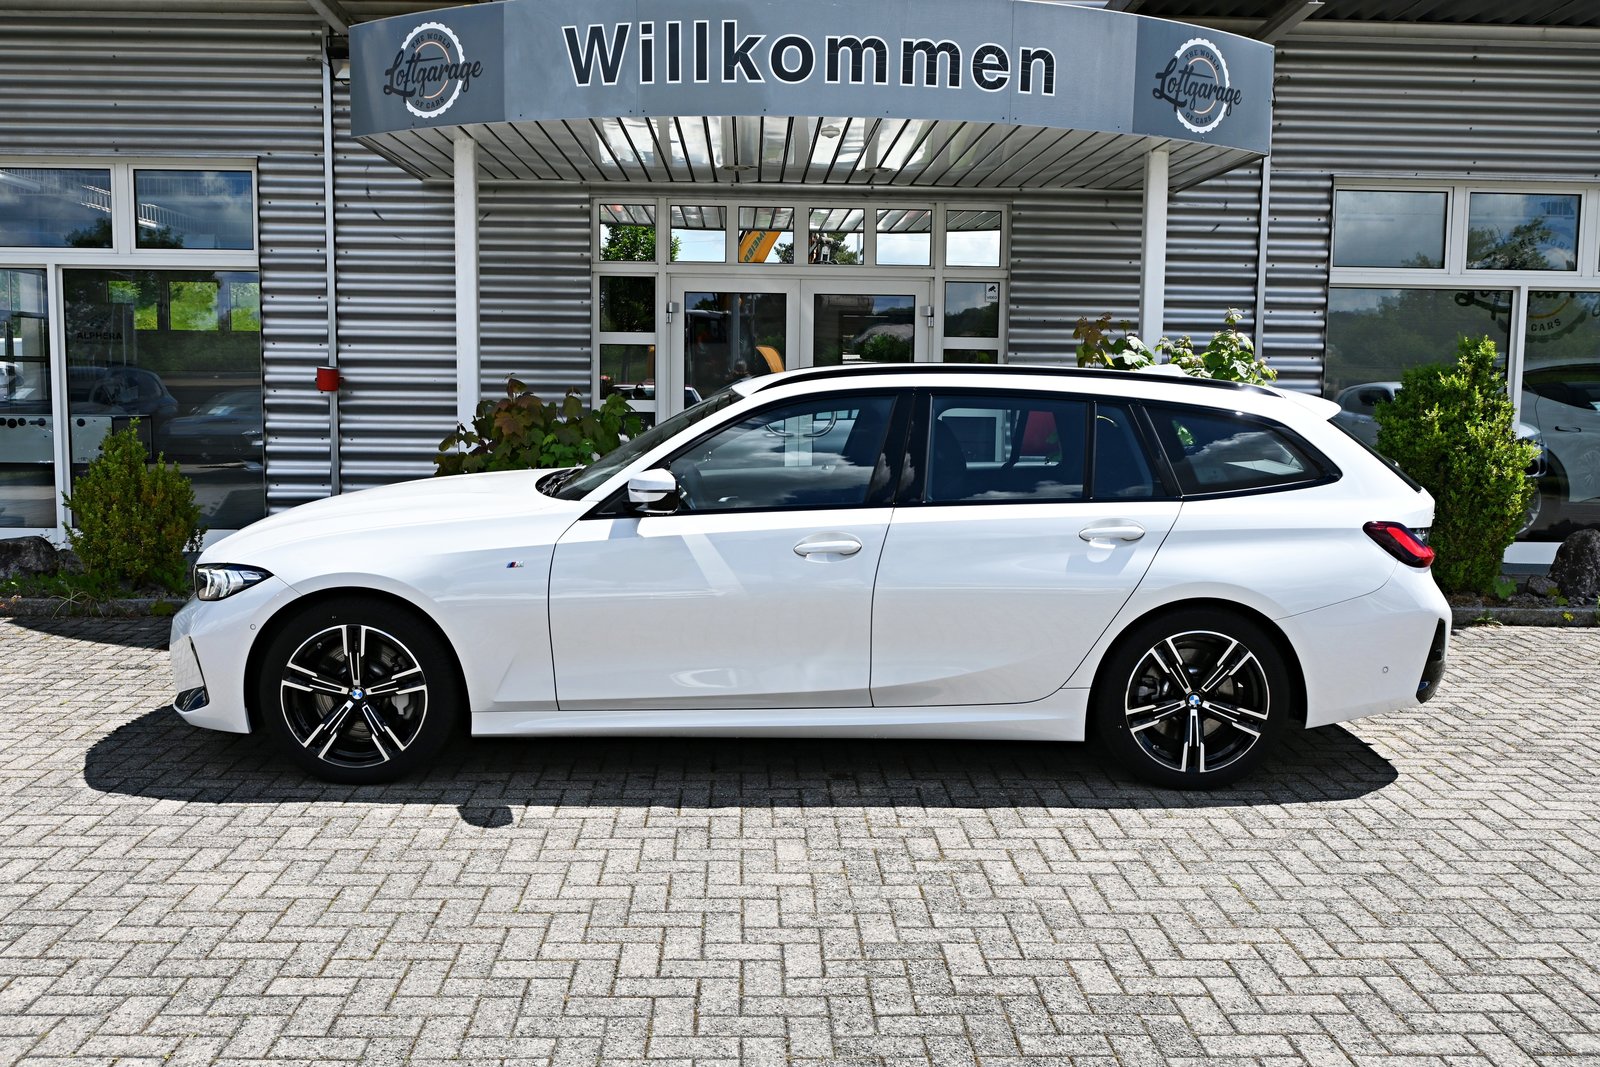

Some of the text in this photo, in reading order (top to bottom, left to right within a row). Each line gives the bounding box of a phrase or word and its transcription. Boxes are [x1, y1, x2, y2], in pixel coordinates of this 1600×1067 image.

[411, 33, 451, 49] THE WORLD
[561, 19, 1056, 97] Willkommen
[1185, 49, 1220, 71] THE WORLD
[383, 48, 483, 104] Loftgarage
[1152, 56, 1242, 117] Loftgarage
[415, 96, 445, 109] OF CARS
[1185, 112, 1212, 124] OF CARS
[1530, 318, 1561, 332] CARS
[76, 331, 123, 340] ALPHERA
